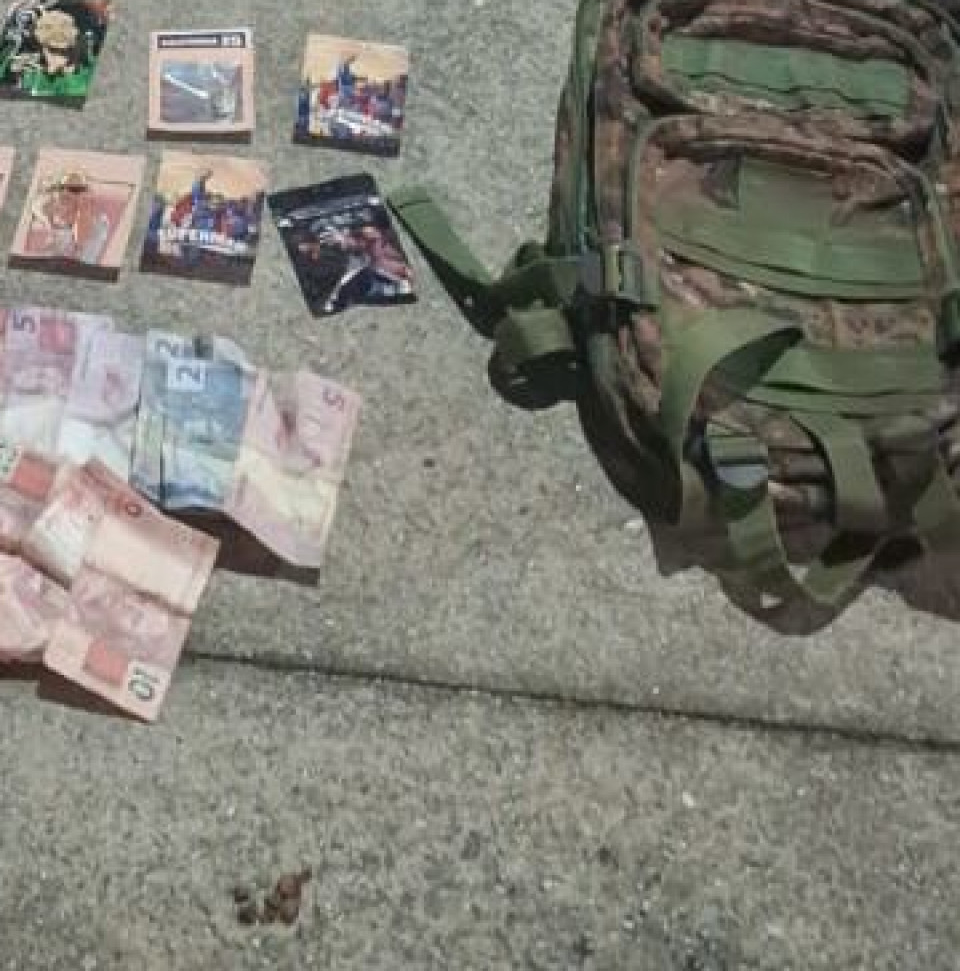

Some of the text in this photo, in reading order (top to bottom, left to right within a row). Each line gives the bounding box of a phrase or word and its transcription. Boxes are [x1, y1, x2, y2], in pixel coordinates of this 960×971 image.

[12, 312, 37, 334] 5
[156, 340, 181, 358] 2
[175, 366, 203, 384] 2
